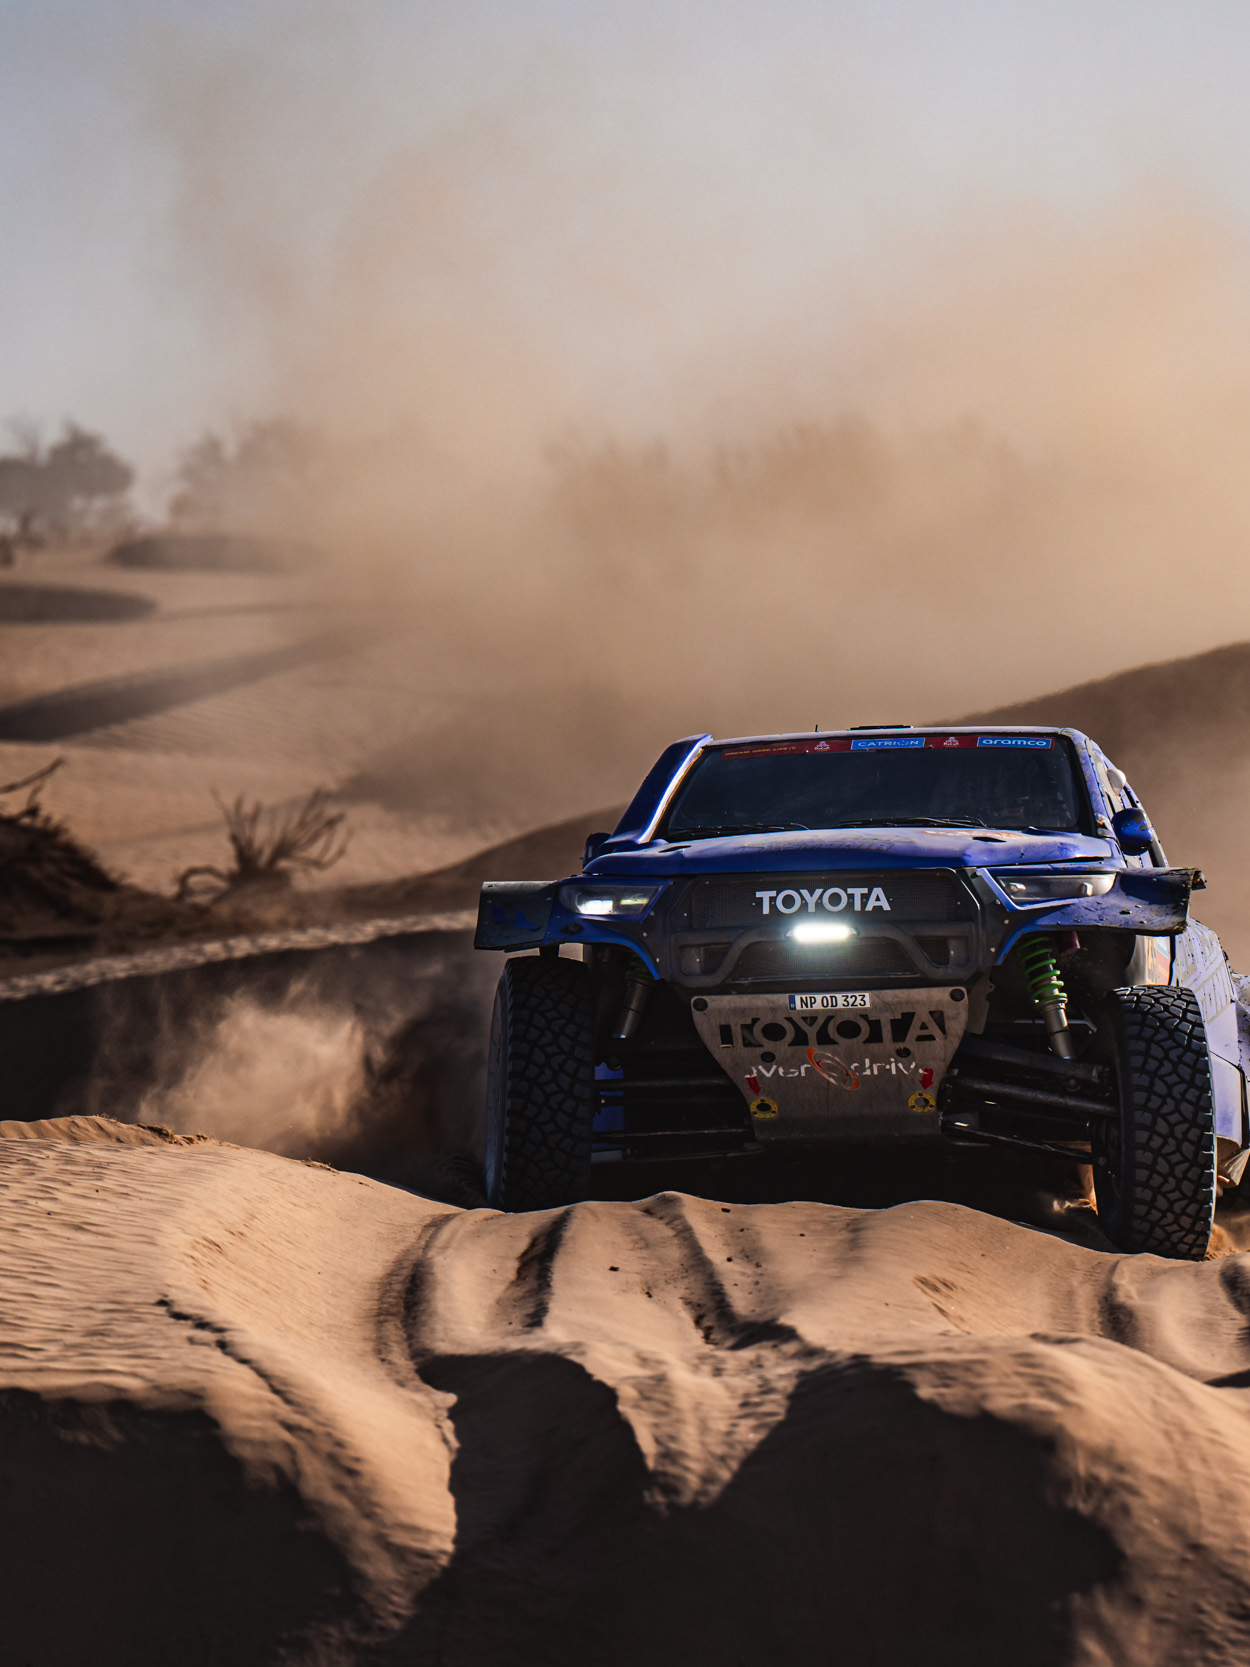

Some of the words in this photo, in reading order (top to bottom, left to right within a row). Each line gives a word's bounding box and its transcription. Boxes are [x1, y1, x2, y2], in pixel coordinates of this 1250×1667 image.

[982, 738, 1047, 746] aramco
[755, 887, 891, 915] TOYOTA
[800, 996, 817, 1009] NP
[841, 994, 867, 1007] 323
[719, 1010, 947, 1048] TOYOTA
[850, 1057, 928, 1076] driv
